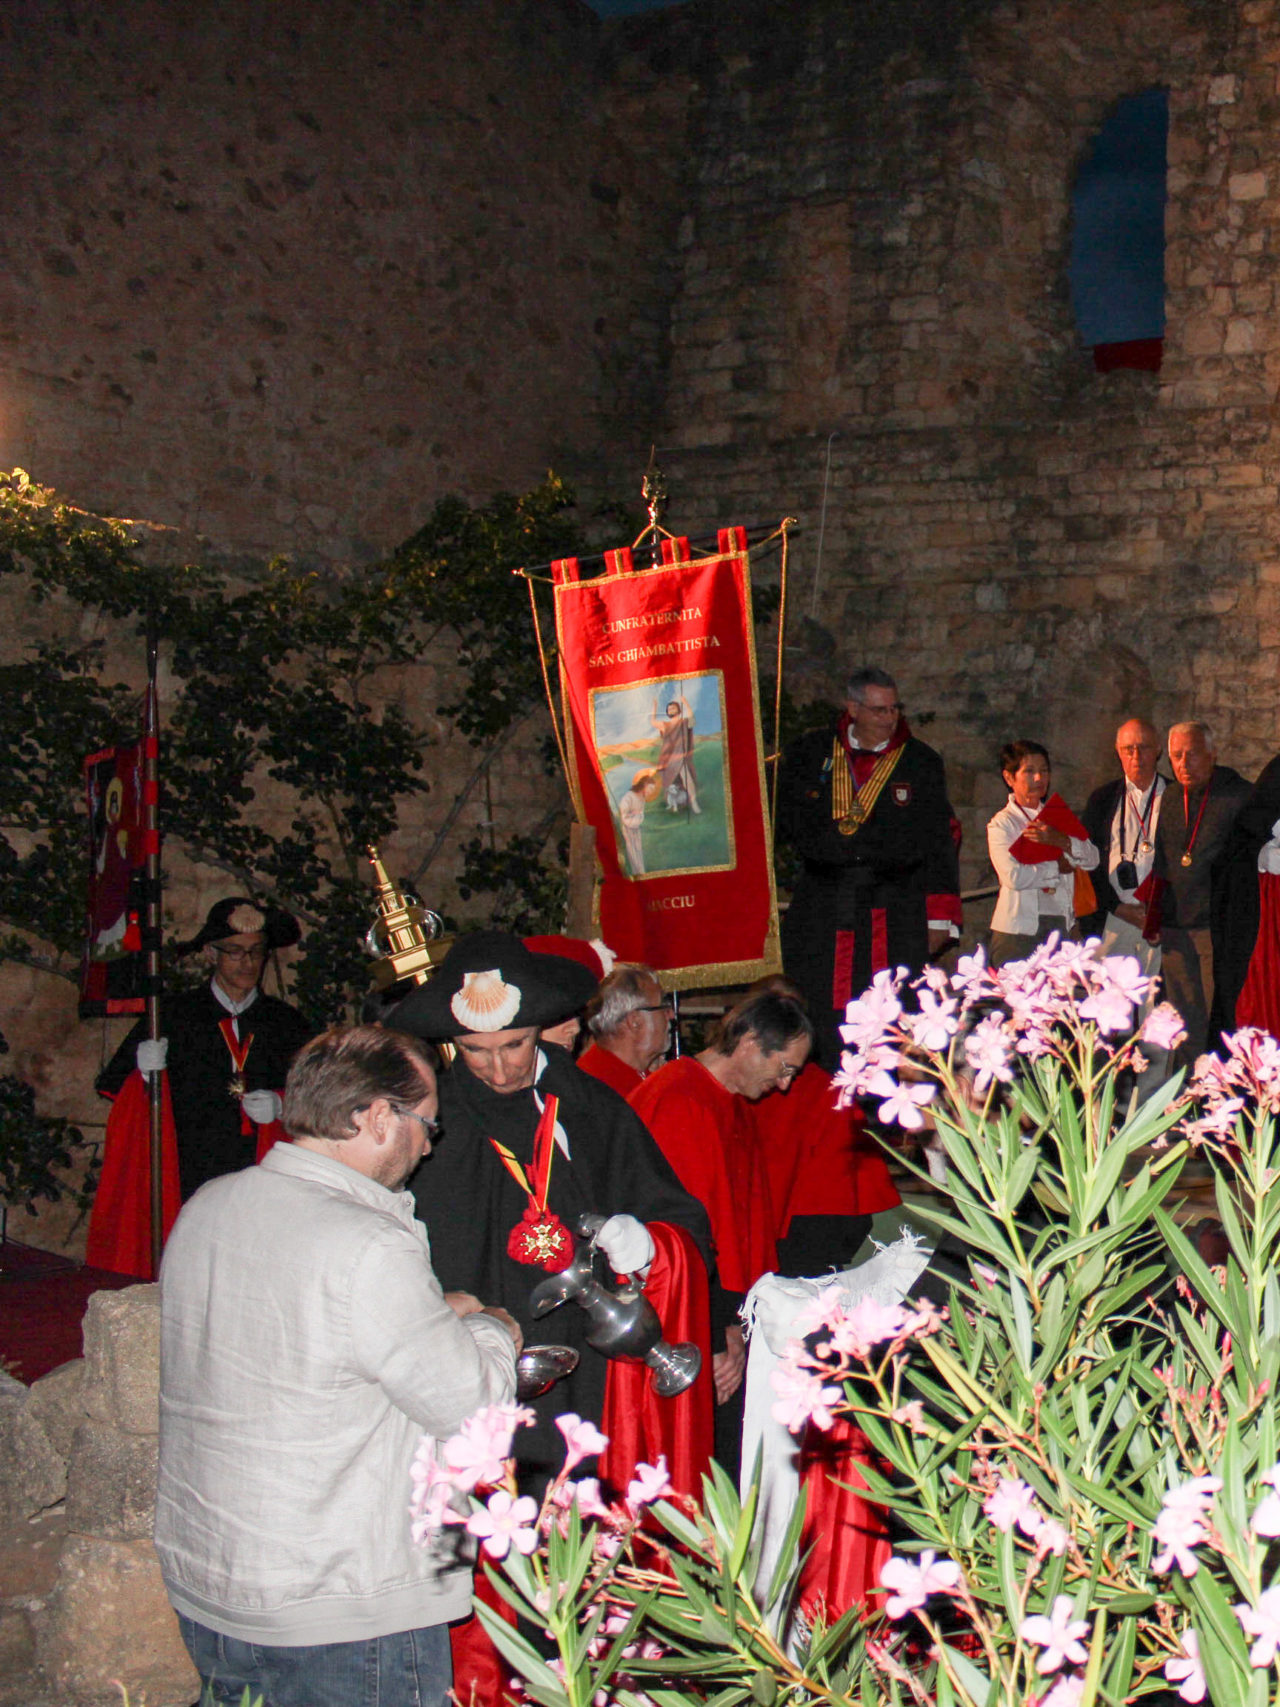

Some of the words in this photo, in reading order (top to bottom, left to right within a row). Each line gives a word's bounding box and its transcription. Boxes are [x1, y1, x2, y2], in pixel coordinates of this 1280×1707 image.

[602, 607, 702, 633] CUNFRATERNITA
[589, 652, 615, 668] SAN
[617, 635, 720, 663] GHJAMBATTISTA
